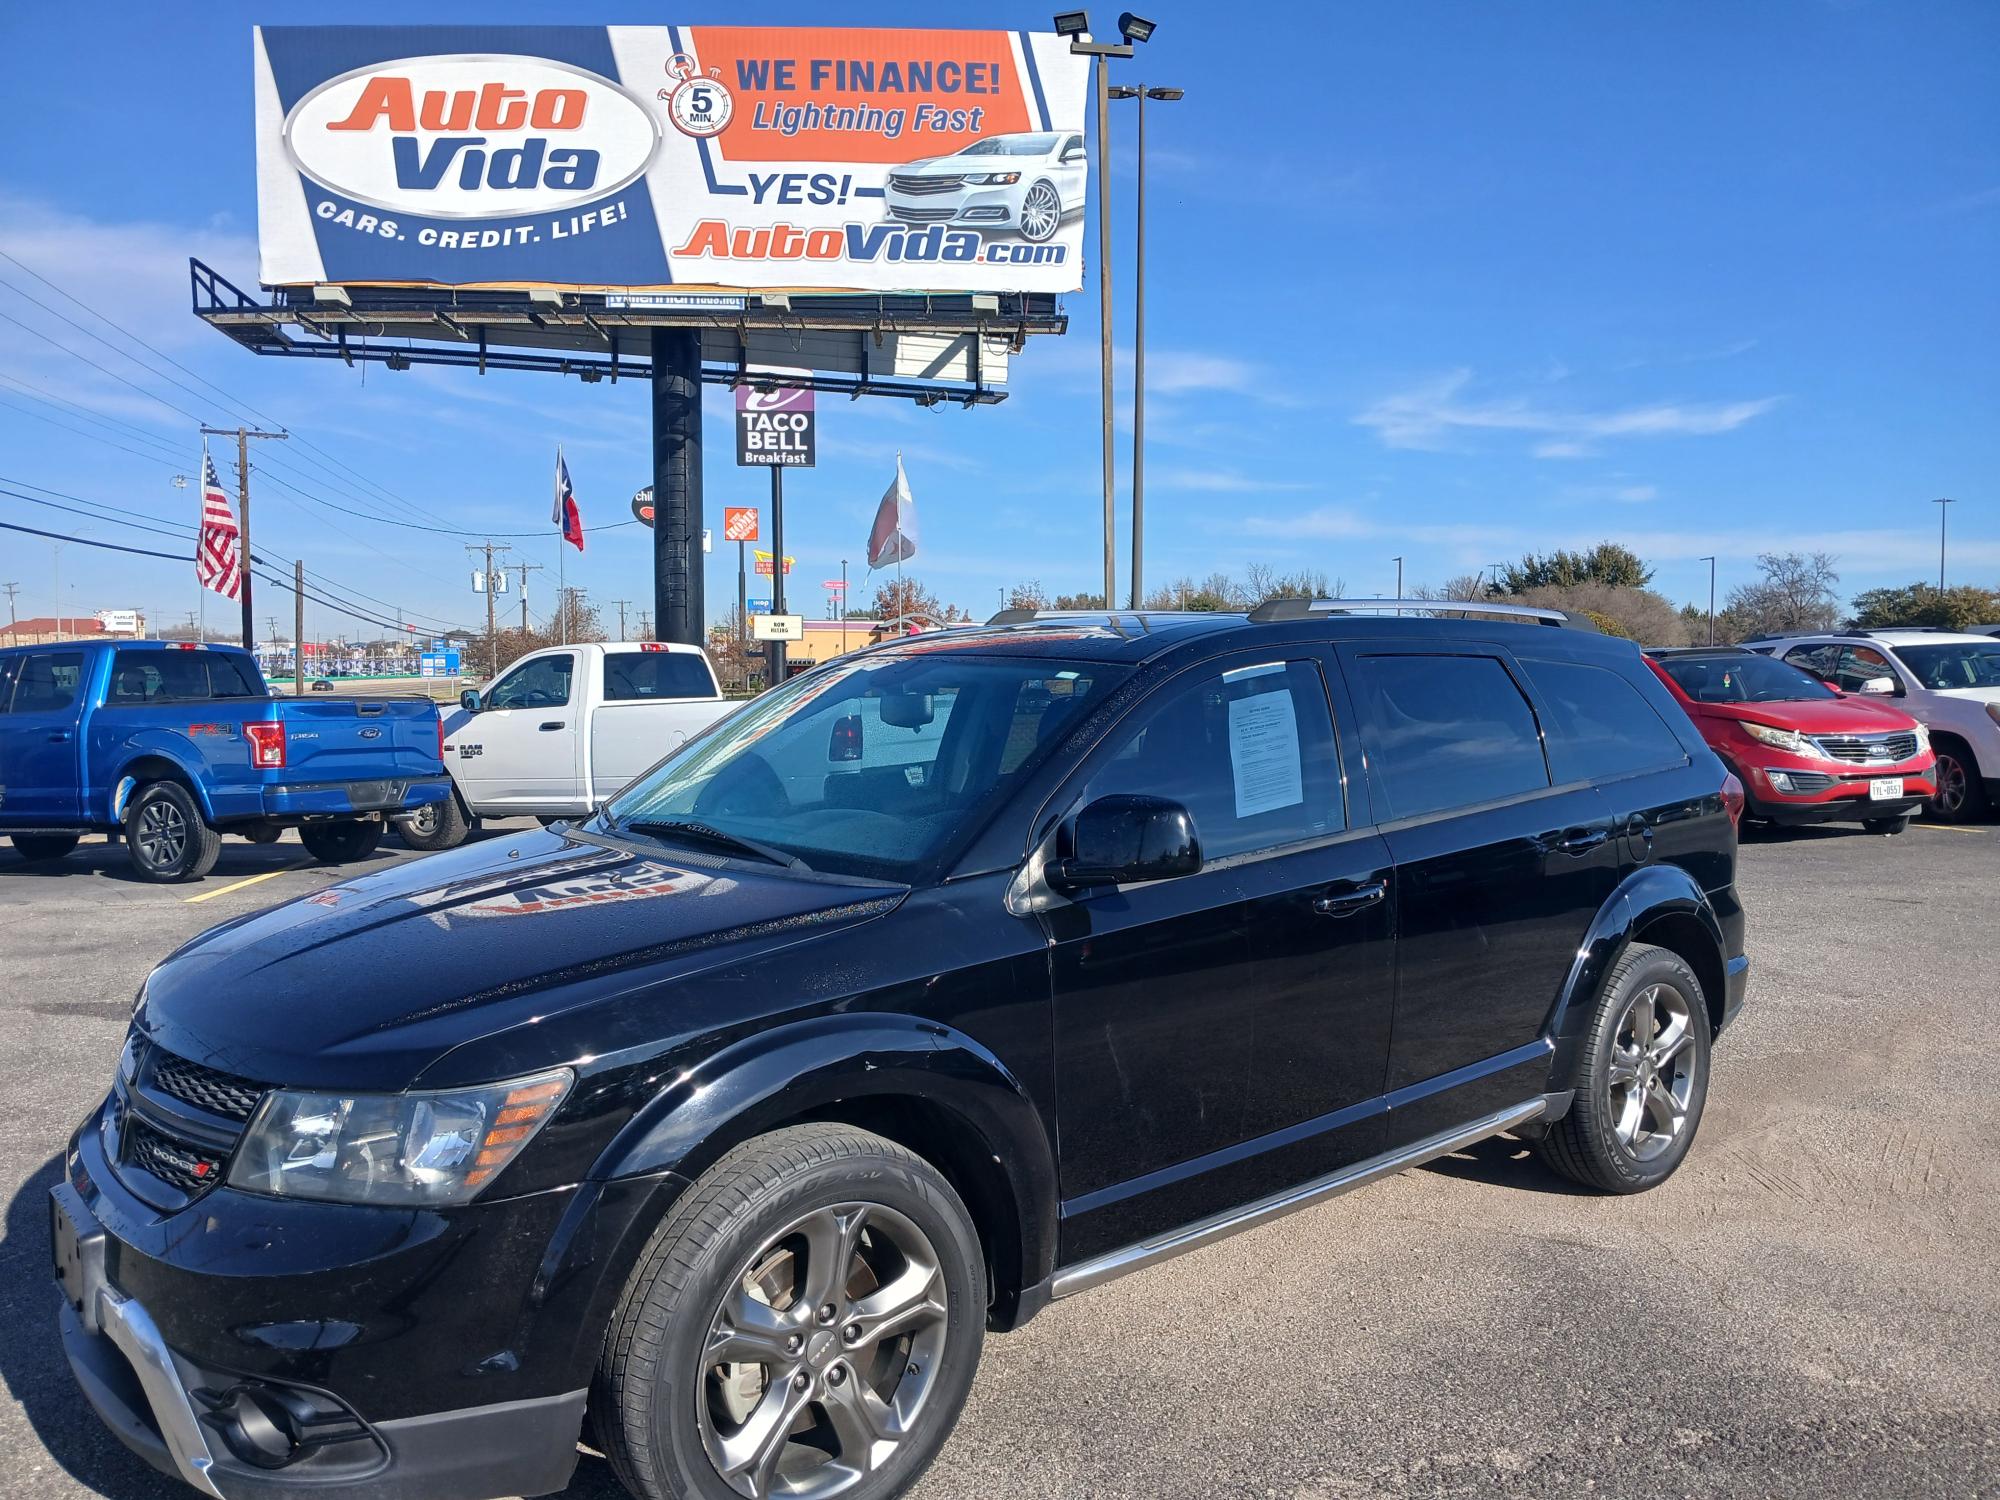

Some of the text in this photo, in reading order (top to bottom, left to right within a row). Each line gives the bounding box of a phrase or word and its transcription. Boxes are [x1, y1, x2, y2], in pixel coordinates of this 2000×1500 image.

[735, 59, 1000, 94] WE FINANCE!
[325, 77, 588, 131] Auto
[691, 88, 713, 114] 5
[753, 103, 984, 137] Lightning Fast
[392, 137, 601, 191] Vida
[748, 173, 852, 206] YES!
[316, 202, 629, 249] CARS. CREDIT. LIFE!
[742, 413, 808, 432] TACO
[747, 431, 808, 450] BELL
[745, 452, 806, 463] Breakfast
[726, 509, 757, 540] HOME
[189, 724, 233, 736] FX4
[153, 1147, 201, 1173] DODGE
